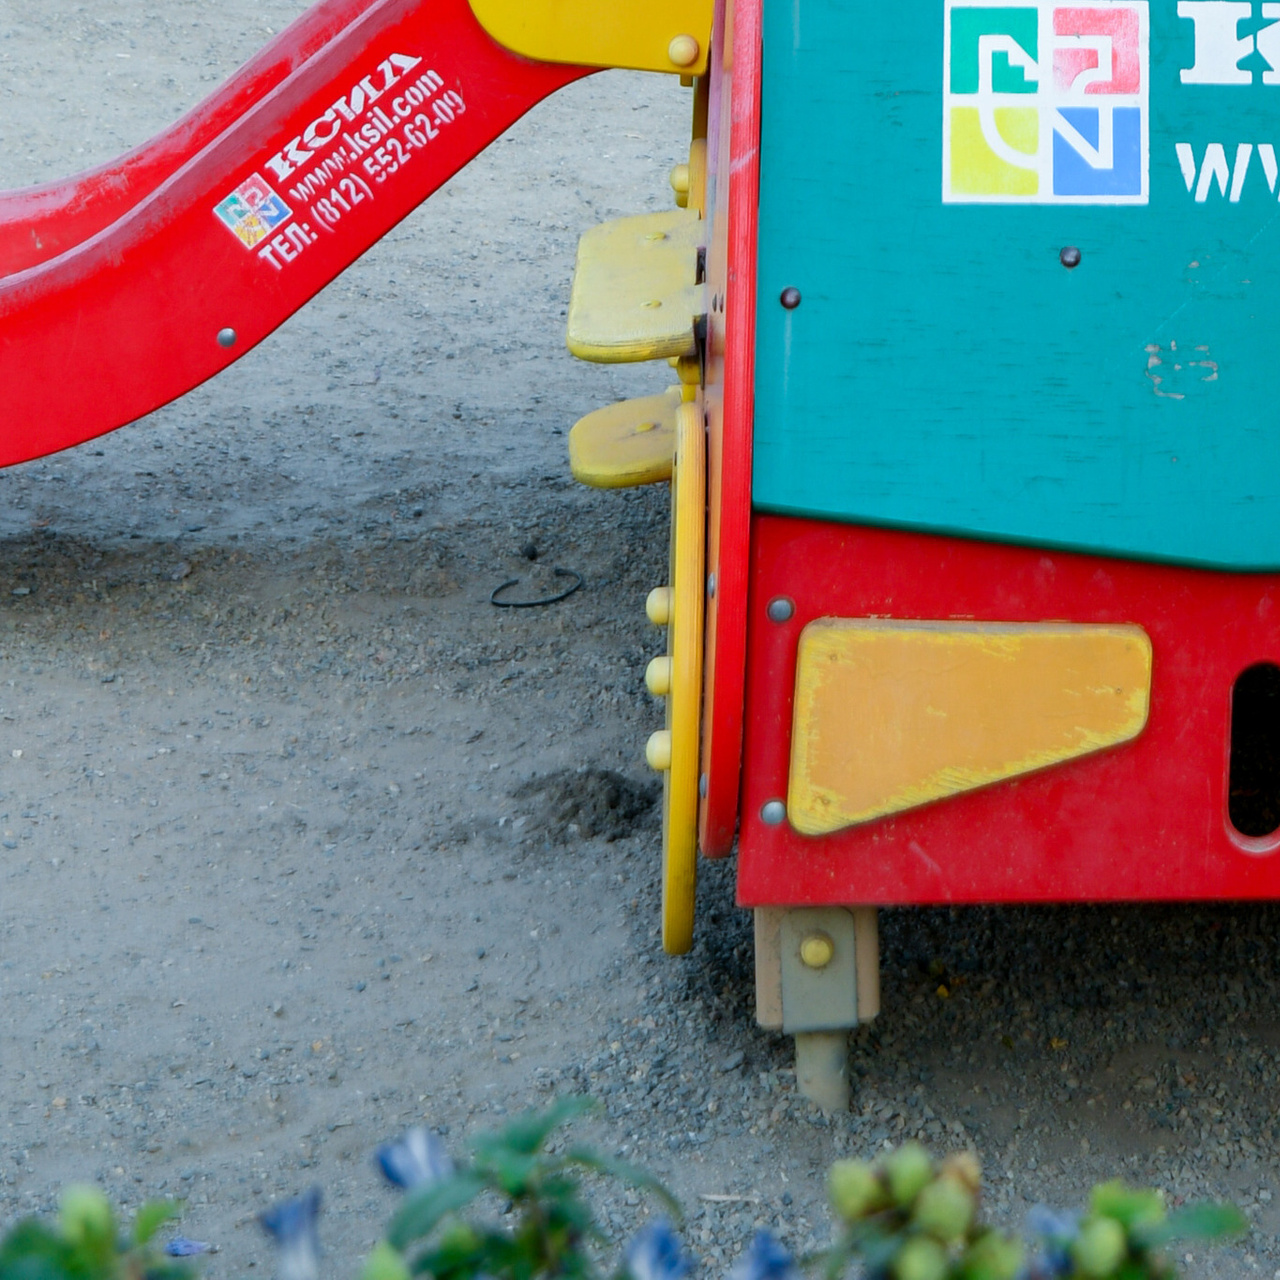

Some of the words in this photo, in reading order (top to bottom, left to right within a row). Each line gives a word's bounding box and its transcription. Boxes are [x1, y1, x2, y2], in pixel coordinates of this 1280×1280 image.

[258, 221, 319, 270] ТЕЛ:
[310, 172, 375, 233] (812)
[363, 89, 467, 183] 552-62-09
[264, 52, 423, 183] КСИЛ
[289, 69, 444, 203] www.ksil.com
